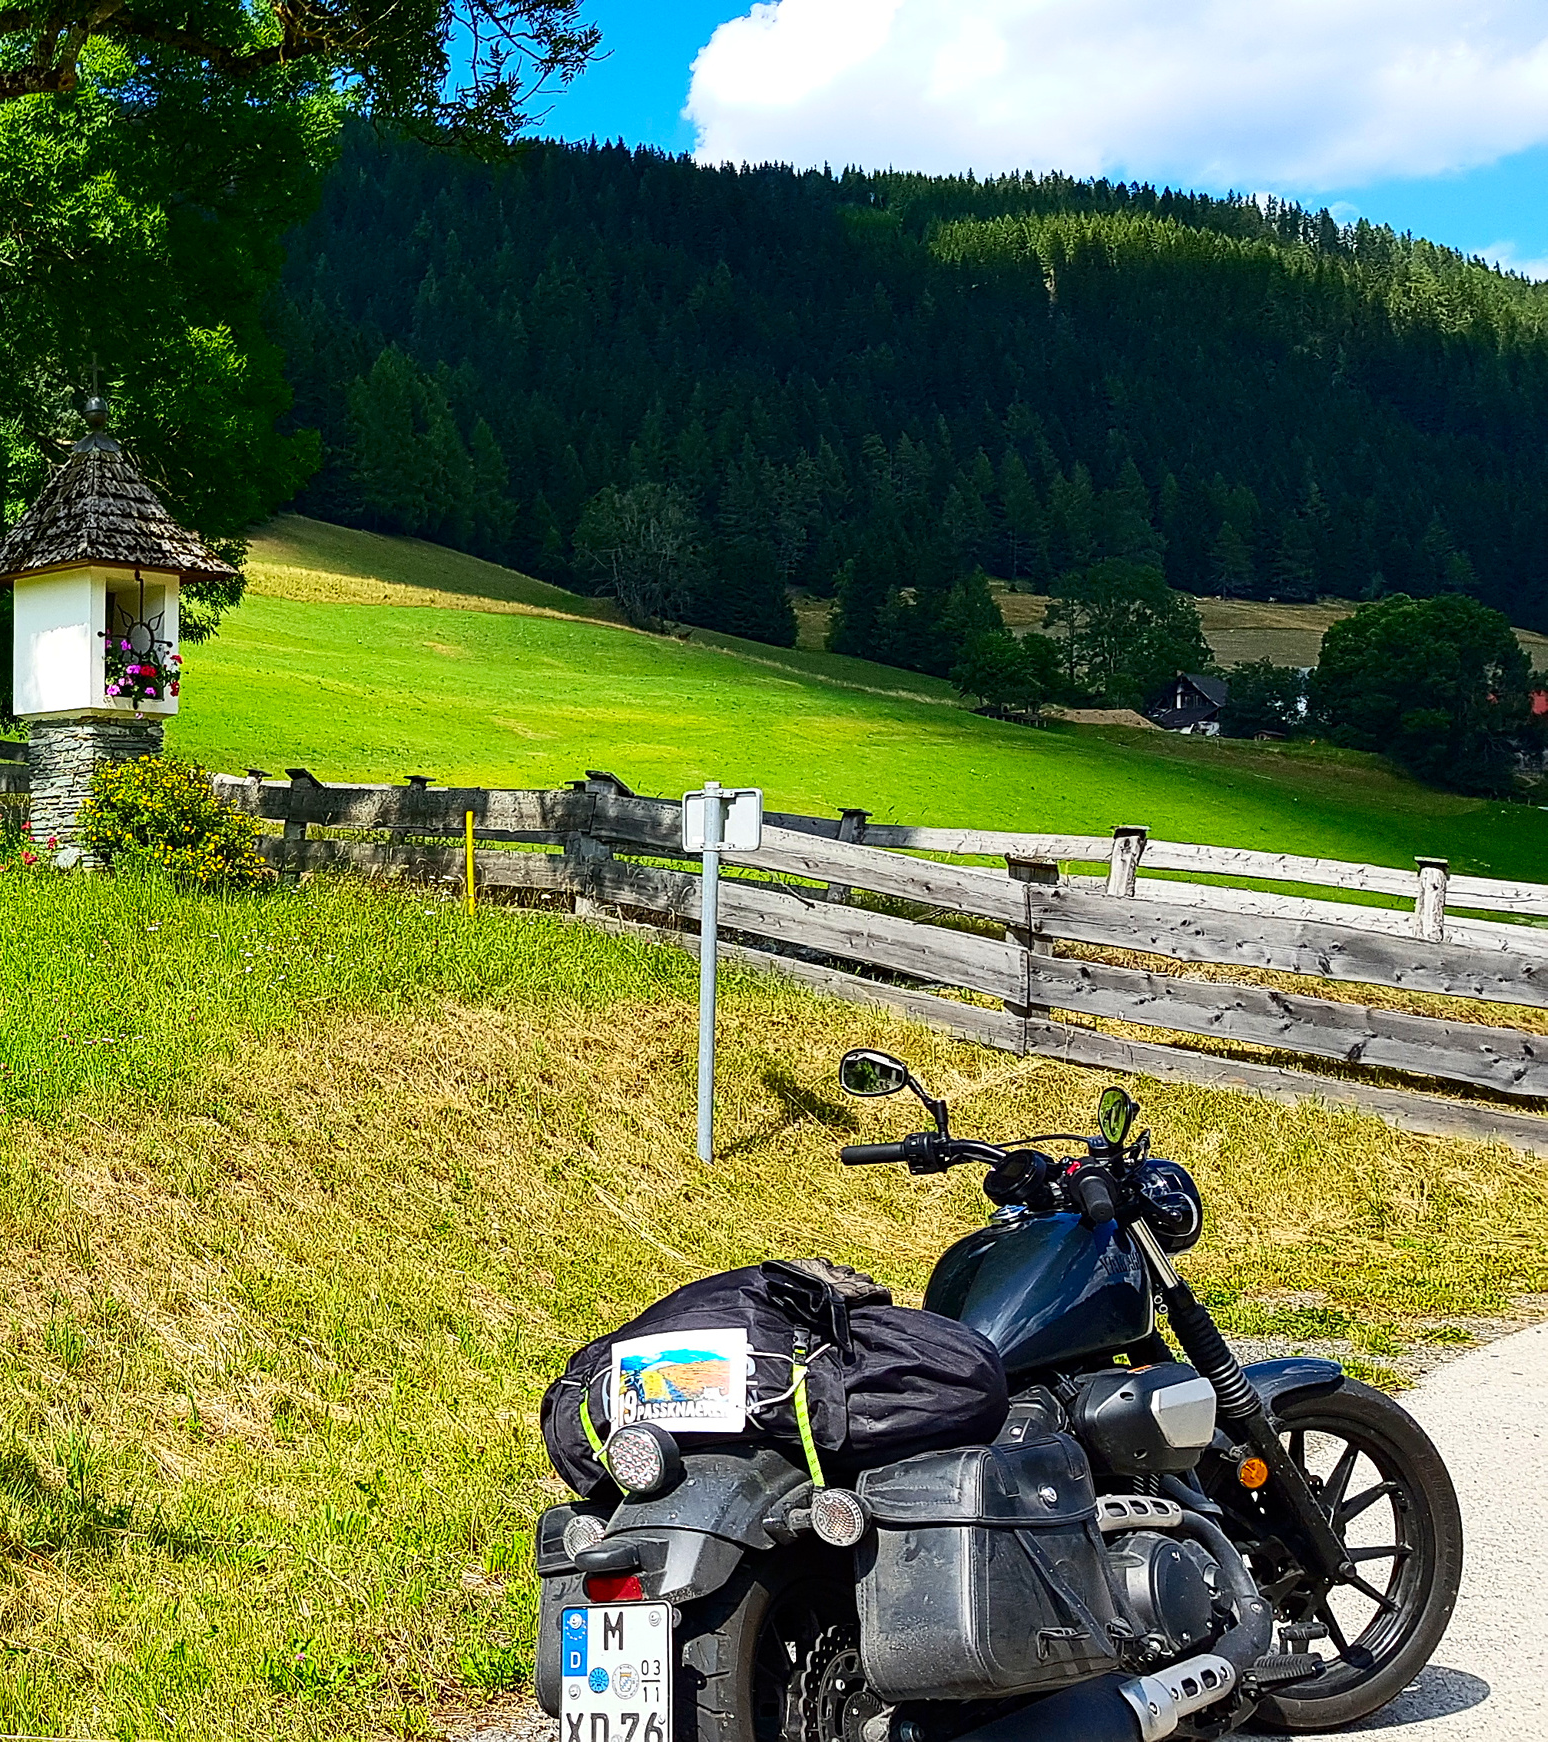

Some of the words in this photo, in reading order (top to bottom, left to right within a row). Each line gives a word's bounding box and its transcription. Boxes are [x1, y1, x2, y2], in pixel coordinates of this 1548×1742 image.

[604, 1611, 623, 1651] M
[570, 1651, 581, 1669] D
[641, 1660, 661, 1676] 03
[643, 1686, 660, 1702] 11
[620, 1712, 664, 1742] 76
